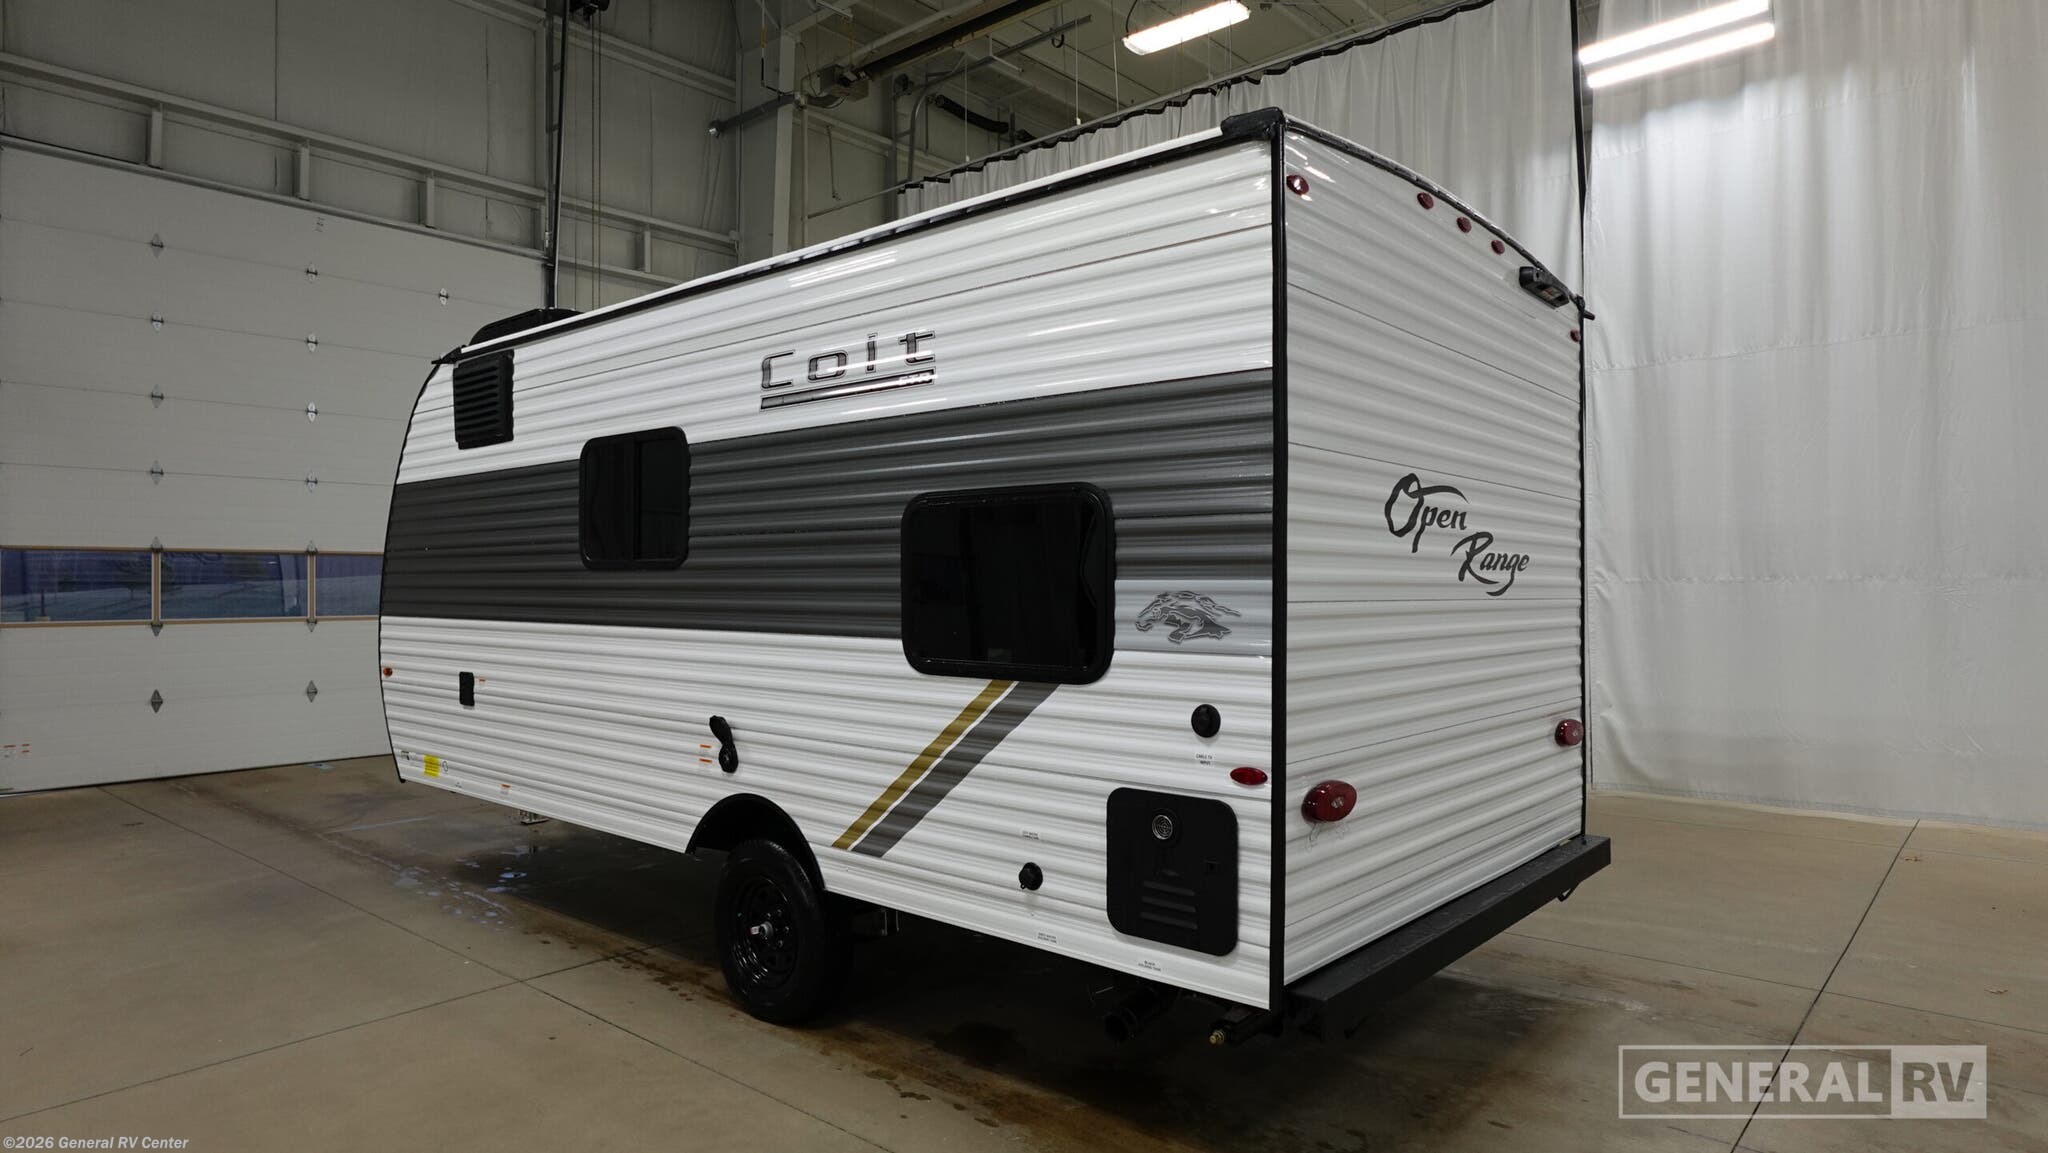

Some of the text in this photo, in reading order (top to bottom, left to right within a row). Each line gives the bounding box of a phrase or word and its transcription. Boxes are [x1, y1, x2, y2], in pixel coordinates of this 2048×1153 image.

[761, 331, 936, 390] Colt
[1384, 472, 1470, 554] Open
[1450, 531, 1530, 597] Range
